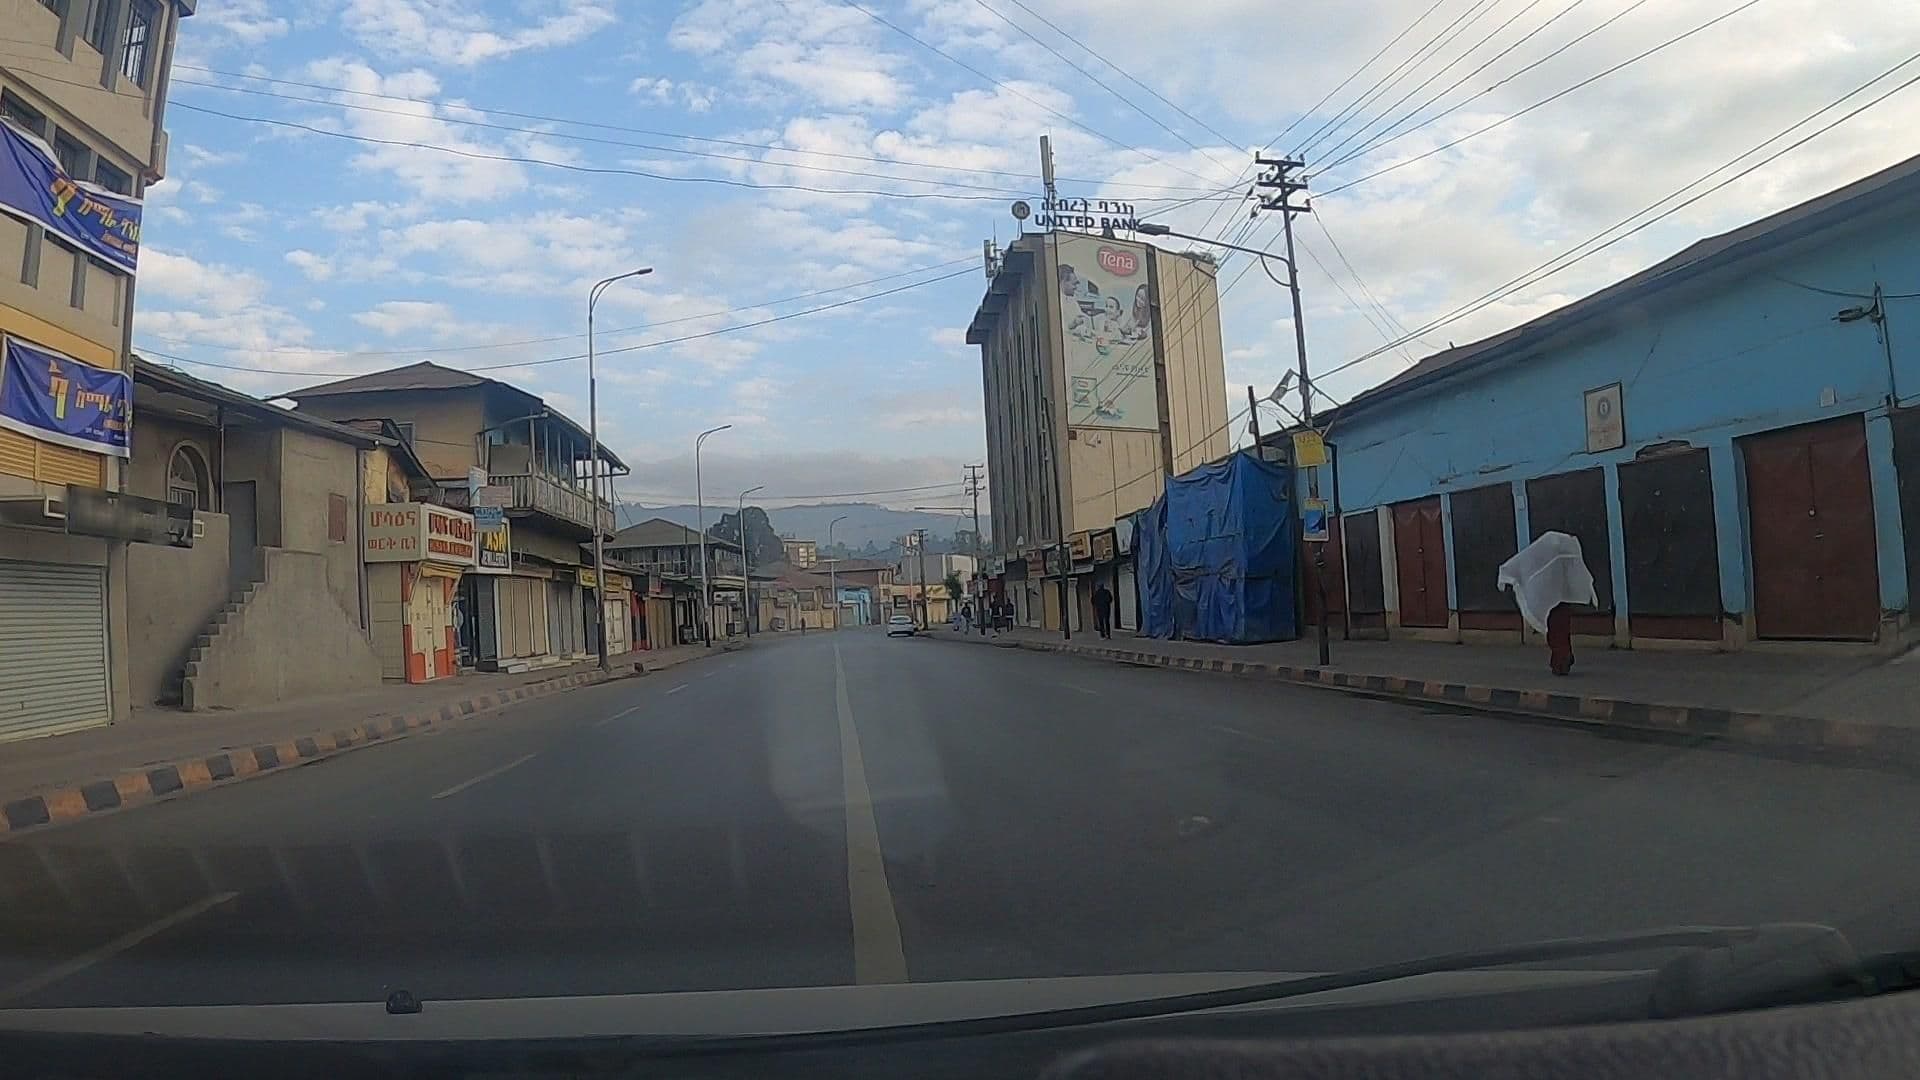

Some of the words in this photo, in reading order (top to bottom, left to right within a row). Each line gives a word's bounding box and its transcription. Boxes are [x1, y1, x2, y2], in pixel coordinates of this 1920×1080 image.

[1035, 214, 1095, 228] UNITED
[1101, 217, 1141, 230] BANK
[1099, 250, 1134, 270] Tena
